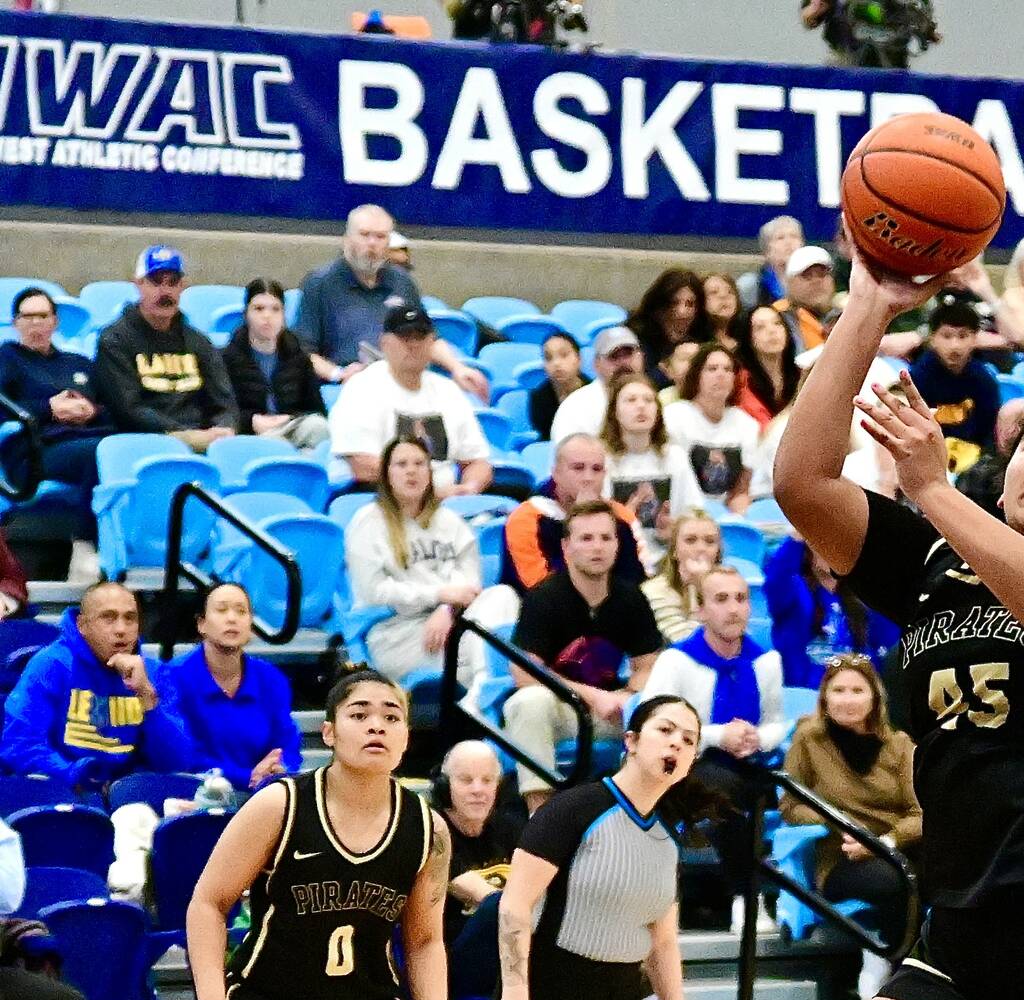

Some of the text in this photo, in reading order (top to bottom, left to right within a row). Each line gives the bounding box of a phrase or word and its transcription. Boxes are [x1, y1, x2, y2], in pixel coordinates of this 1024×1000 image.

[51, 138, 160, 172] ATHLETIC
[161, 143, 305, 181] CONFERENCE
[928, 662, 1010, 730] 45
[291, 880, 408, 922] PIRATES
[325, 924, 355, 977] 0
